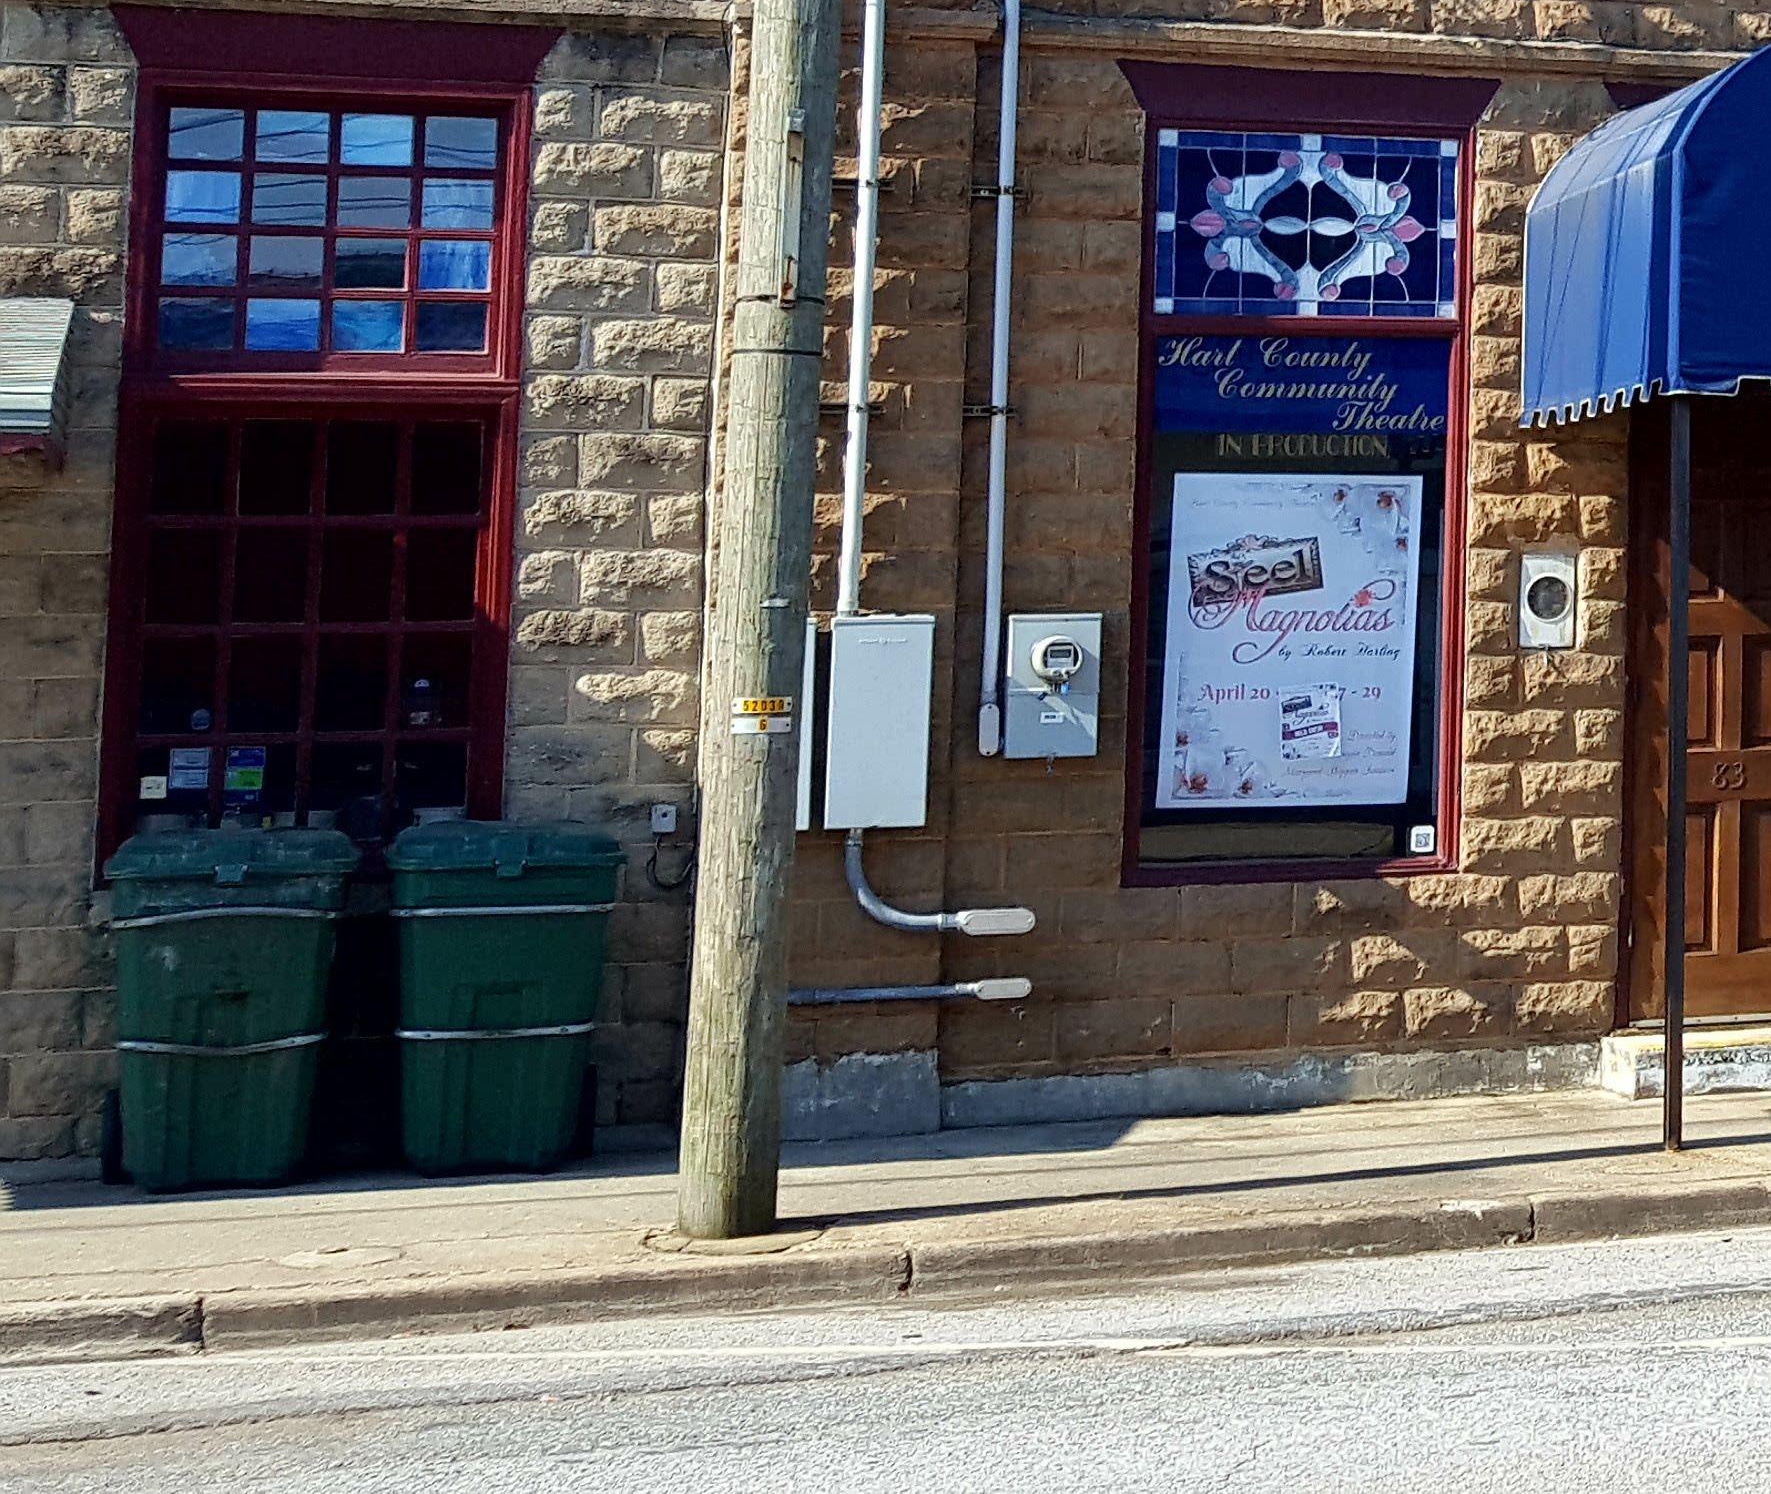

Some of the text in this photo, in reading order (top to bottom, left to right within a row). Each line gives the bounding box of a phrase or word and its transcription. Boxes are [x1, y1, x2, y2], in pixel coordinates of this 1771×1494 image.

[1158, 336, 1373, 381] Hart County
[1214, 368, 1399, 412] Community
[1332, 401, 1445, 431] Theatre
[1205, 549, 1312, 594] Steel
[1188, 579, 1396, 664] Magnolias
[1197, 682, 1246, 705] April
[1250, 687, 1270, 701] 20
[1361, 686, 1382, 700] 29
[1712, 762, 1745, 789] 83
